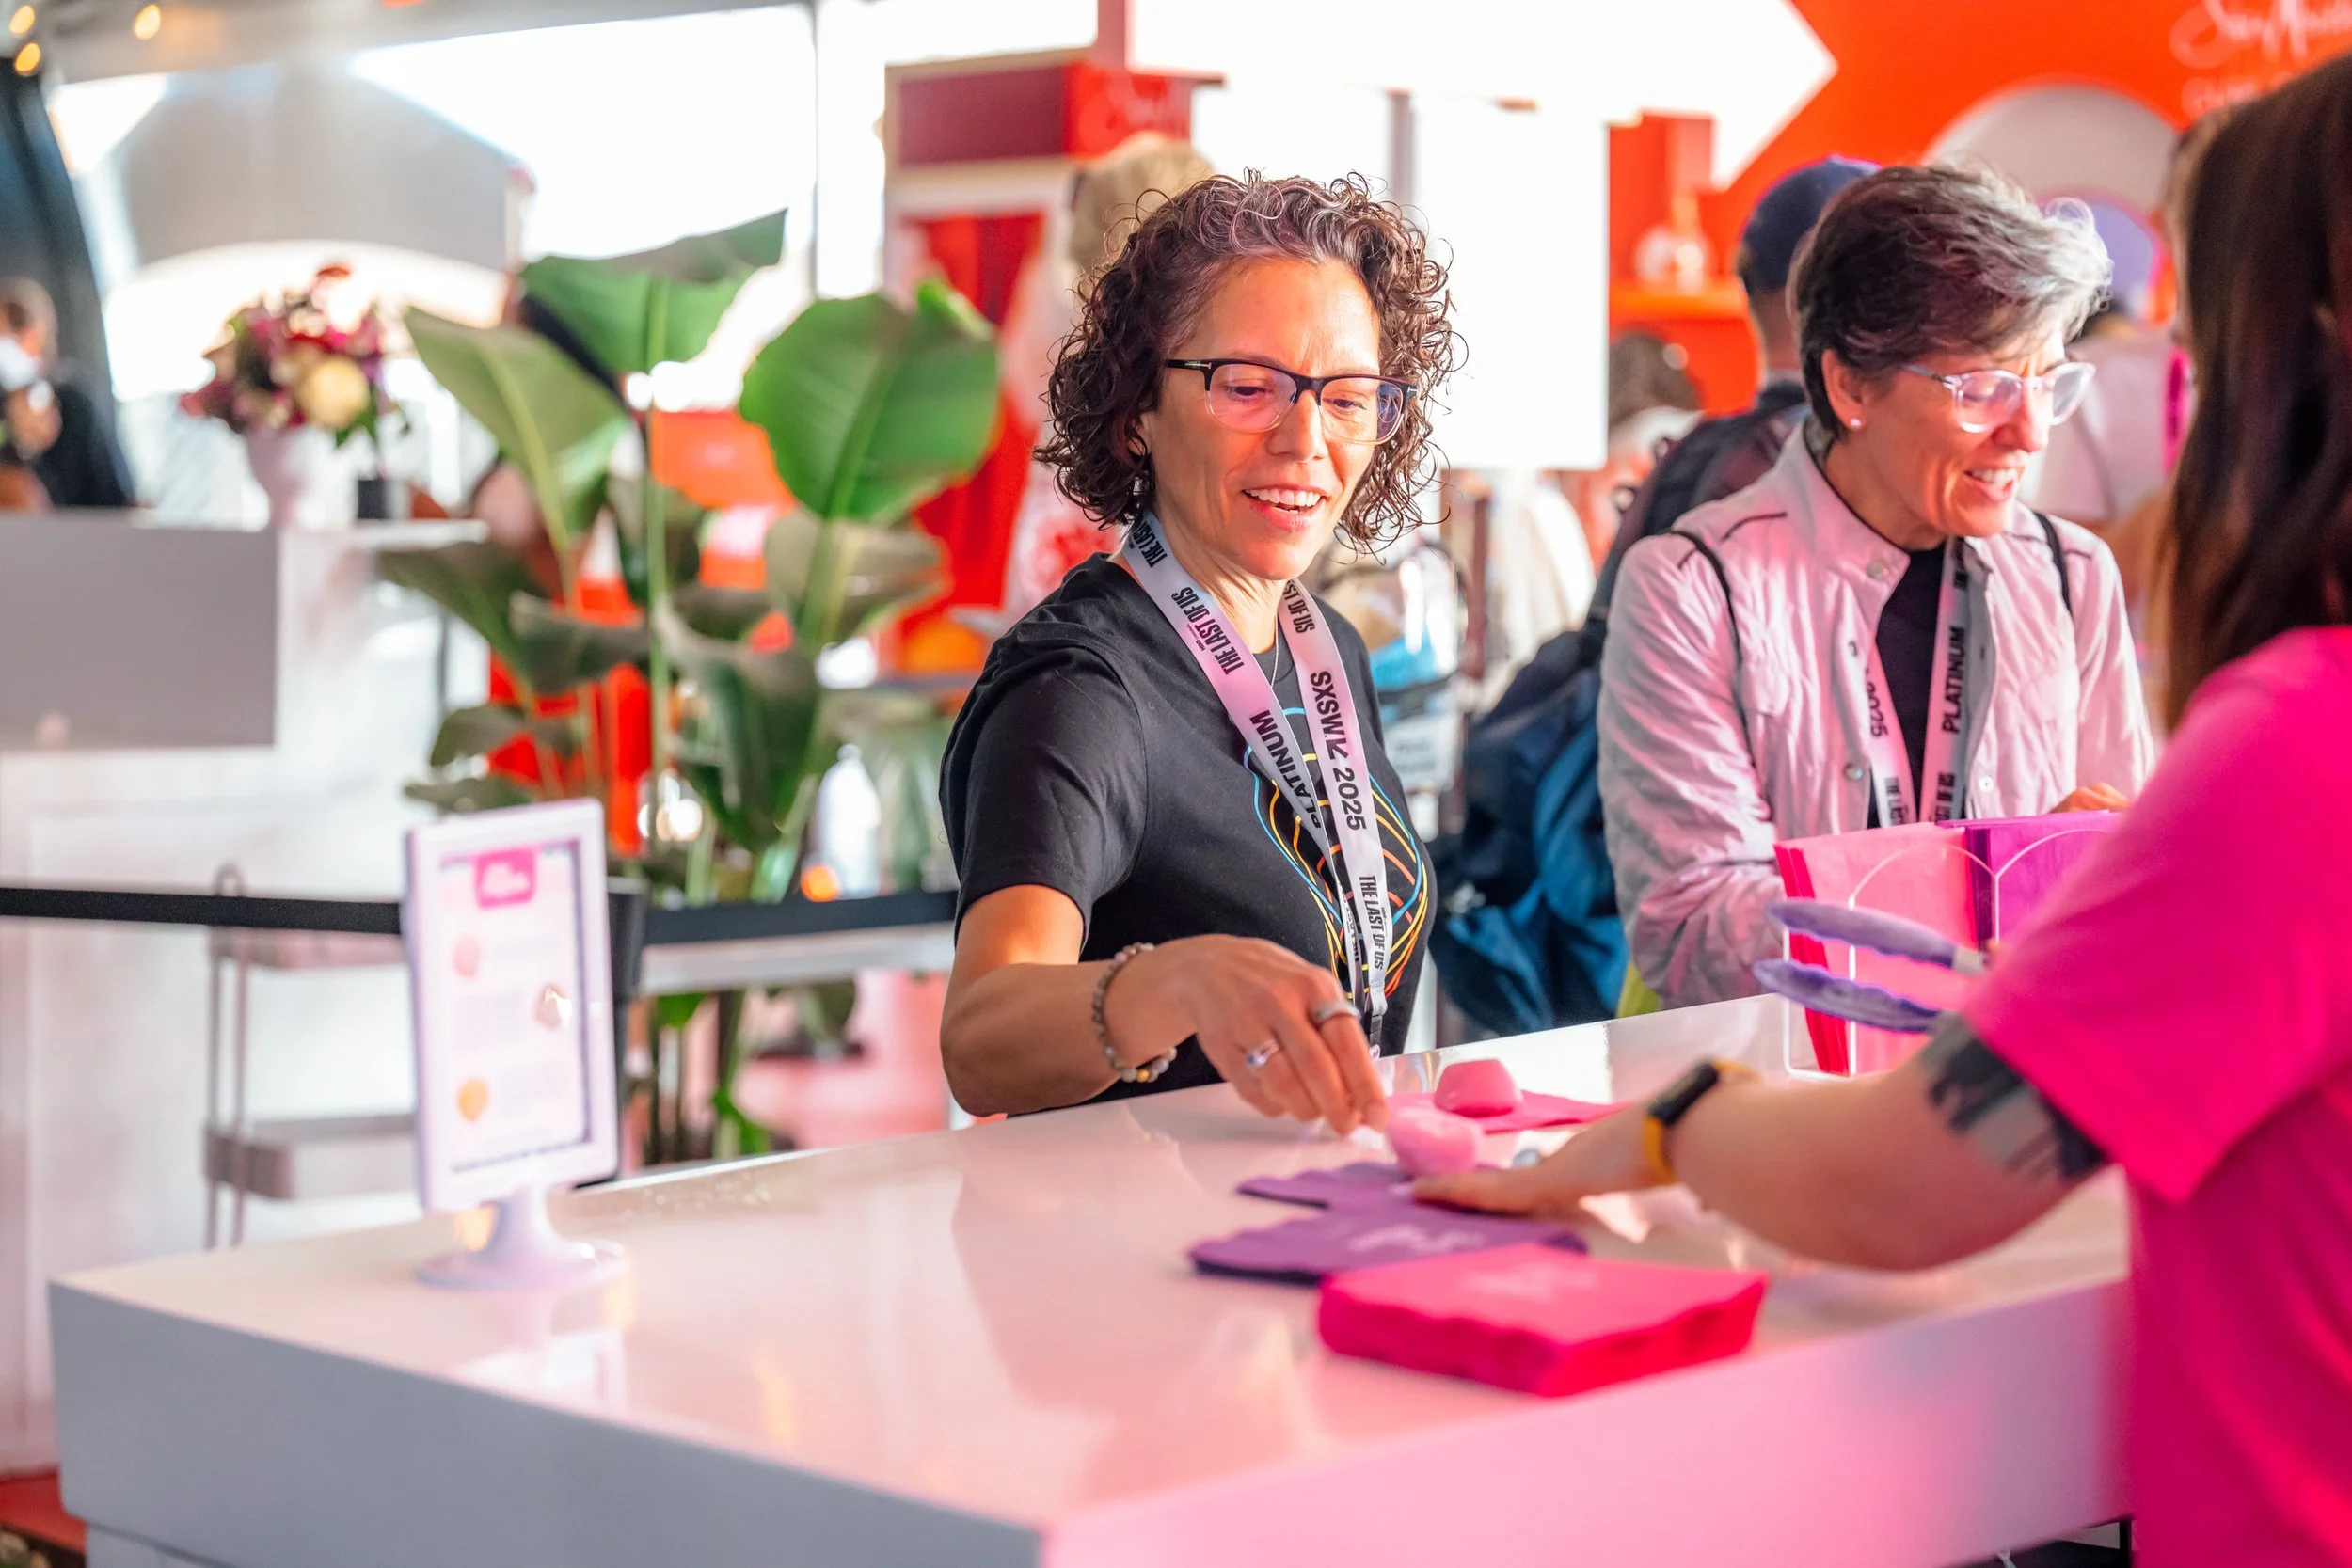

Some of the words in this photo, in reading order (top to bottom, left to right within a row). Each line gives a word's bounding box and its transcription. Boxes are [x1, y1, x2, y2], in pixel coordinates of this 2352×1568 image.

[1141, 539, 1168, 568] THE
[1171, 587, 1200, 609] US
[1283, 579, 1300, 600] ST
[1183, 604, 1211, 624] OF
[1288, 599, 1309, 614] OF
[1293, 614, 1315, 633] US
[1194, 618, 1232, 653] LAST
[1215, 646, 1245, 675] THE
[1942, 626, 1966, 735] PLATINUM
[1249, 709, 1322, 829] PLATINUM
[1332, 767, 1367, 832] 2025
[1359, 876, 1378, 898] THE
[1364, 900, 1385, 932] LAST
[1373, 933, 1386, 950] OF
[1374, 951, 1385, 971] US
